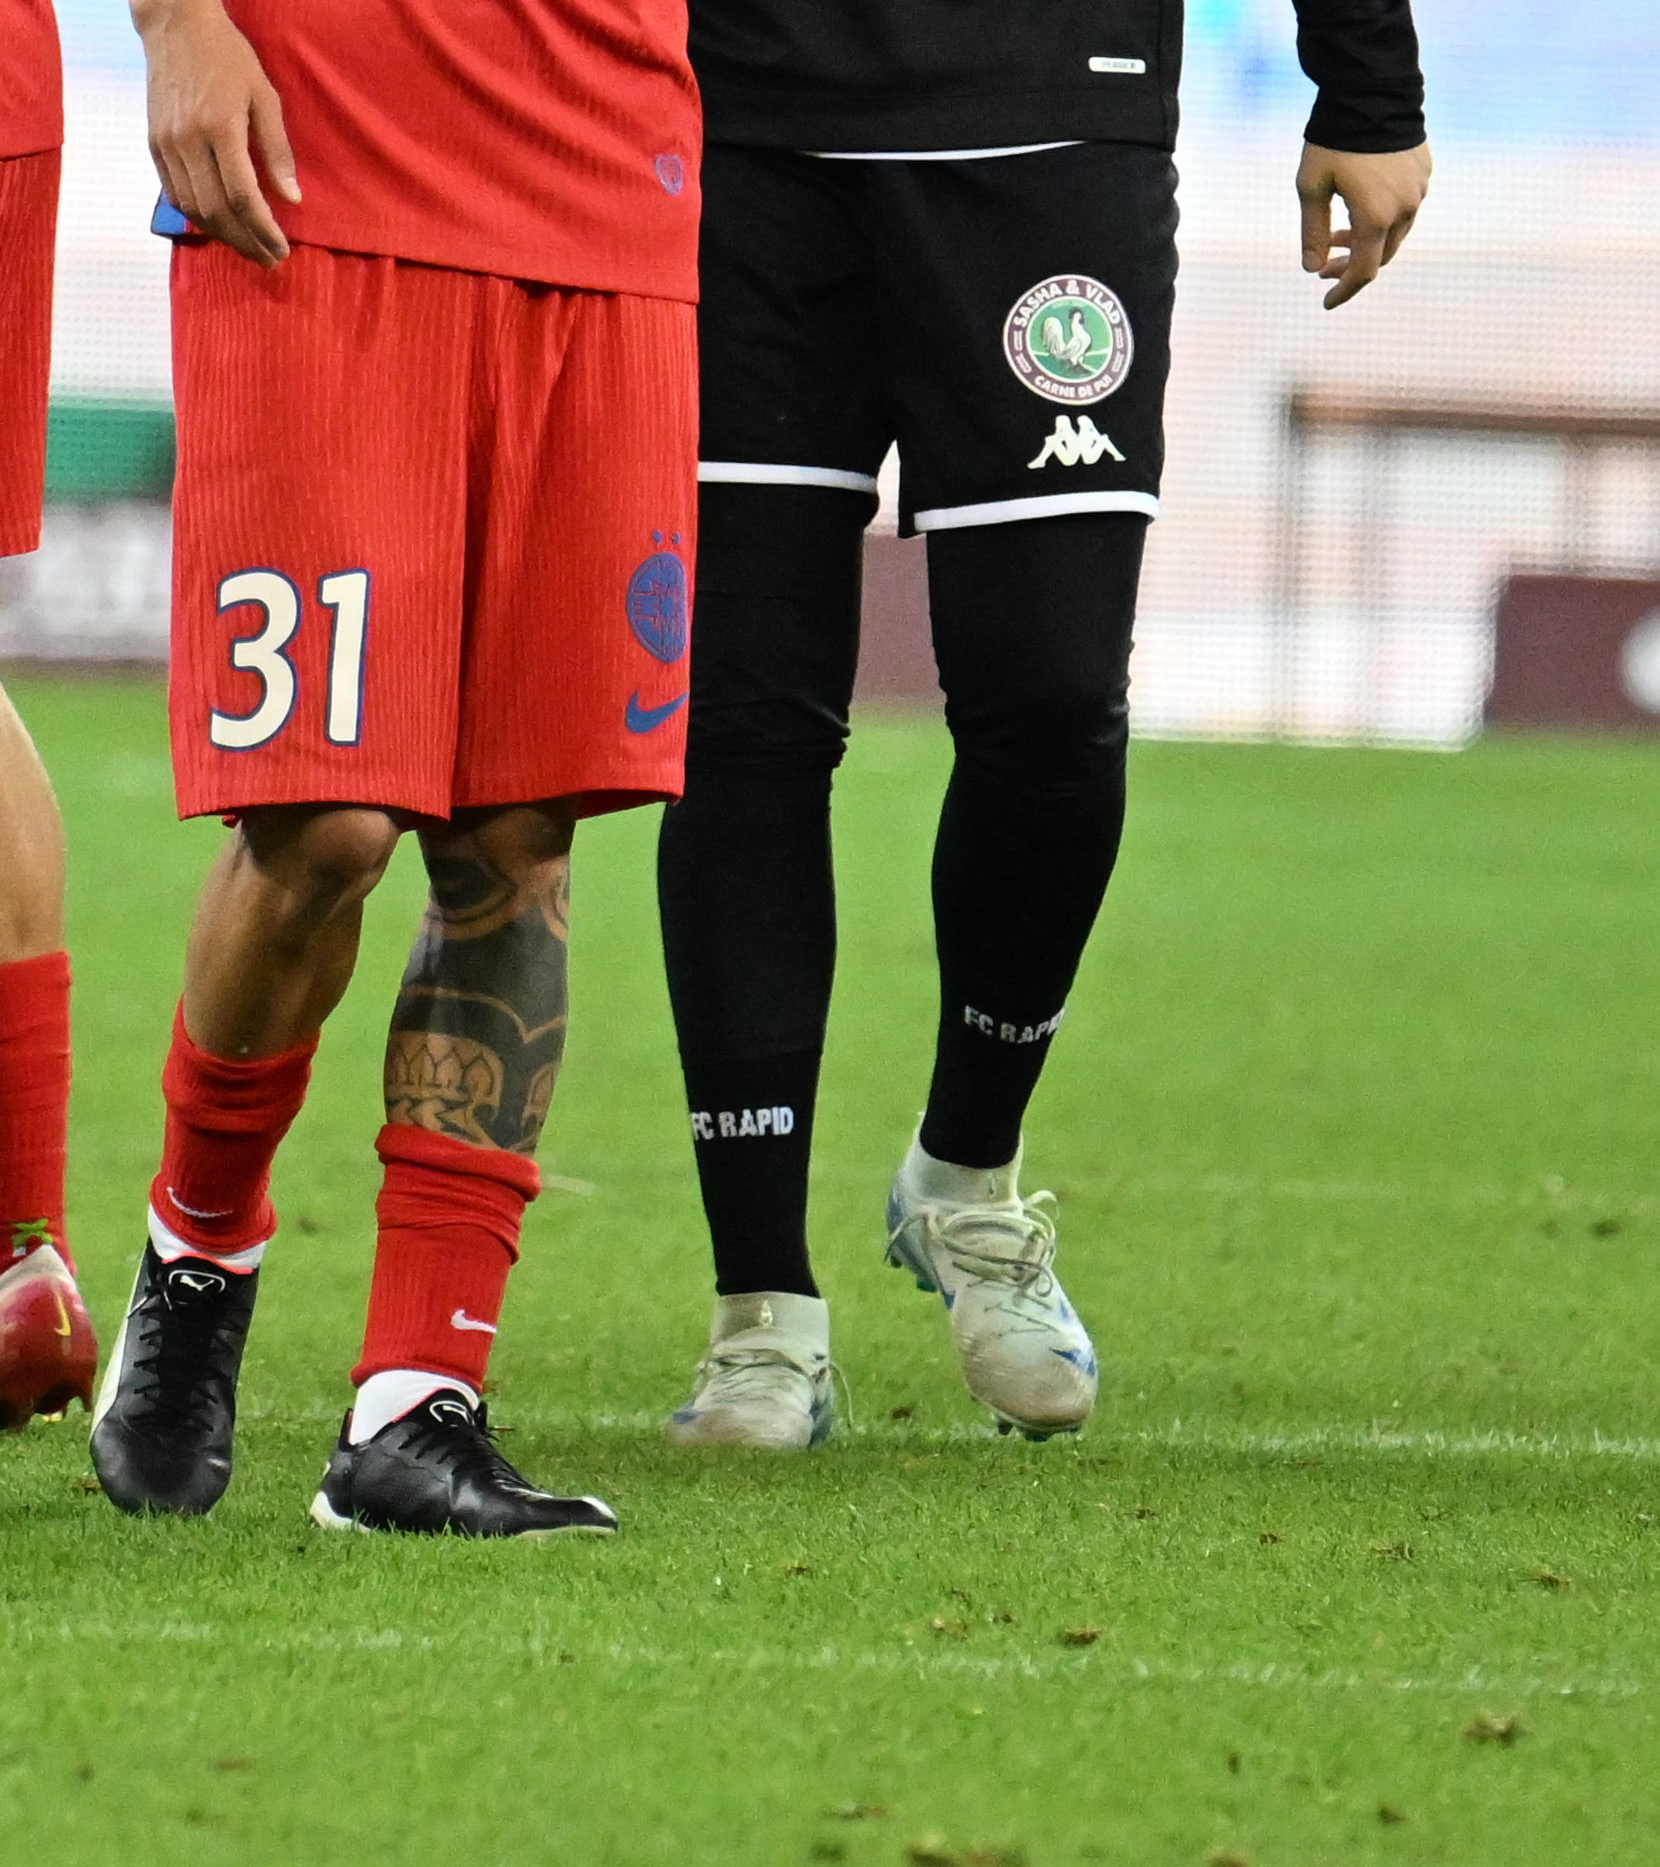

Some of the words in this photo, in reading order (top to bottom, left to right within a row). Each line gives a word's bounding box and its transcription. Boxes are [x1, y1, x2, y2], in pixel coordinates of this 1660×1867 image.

[1012, 282, 1064, 328] SASHA
[1065, 279, 1080, 295] &
[1085, 283, 1122, 325] VLAD
[1034, 375, 1077, 398] CARNE
[209, 566, 372, 753] 31
[963, 1004, 994, 1037] FC
[718, 1105, 795, 1138] RAPID
